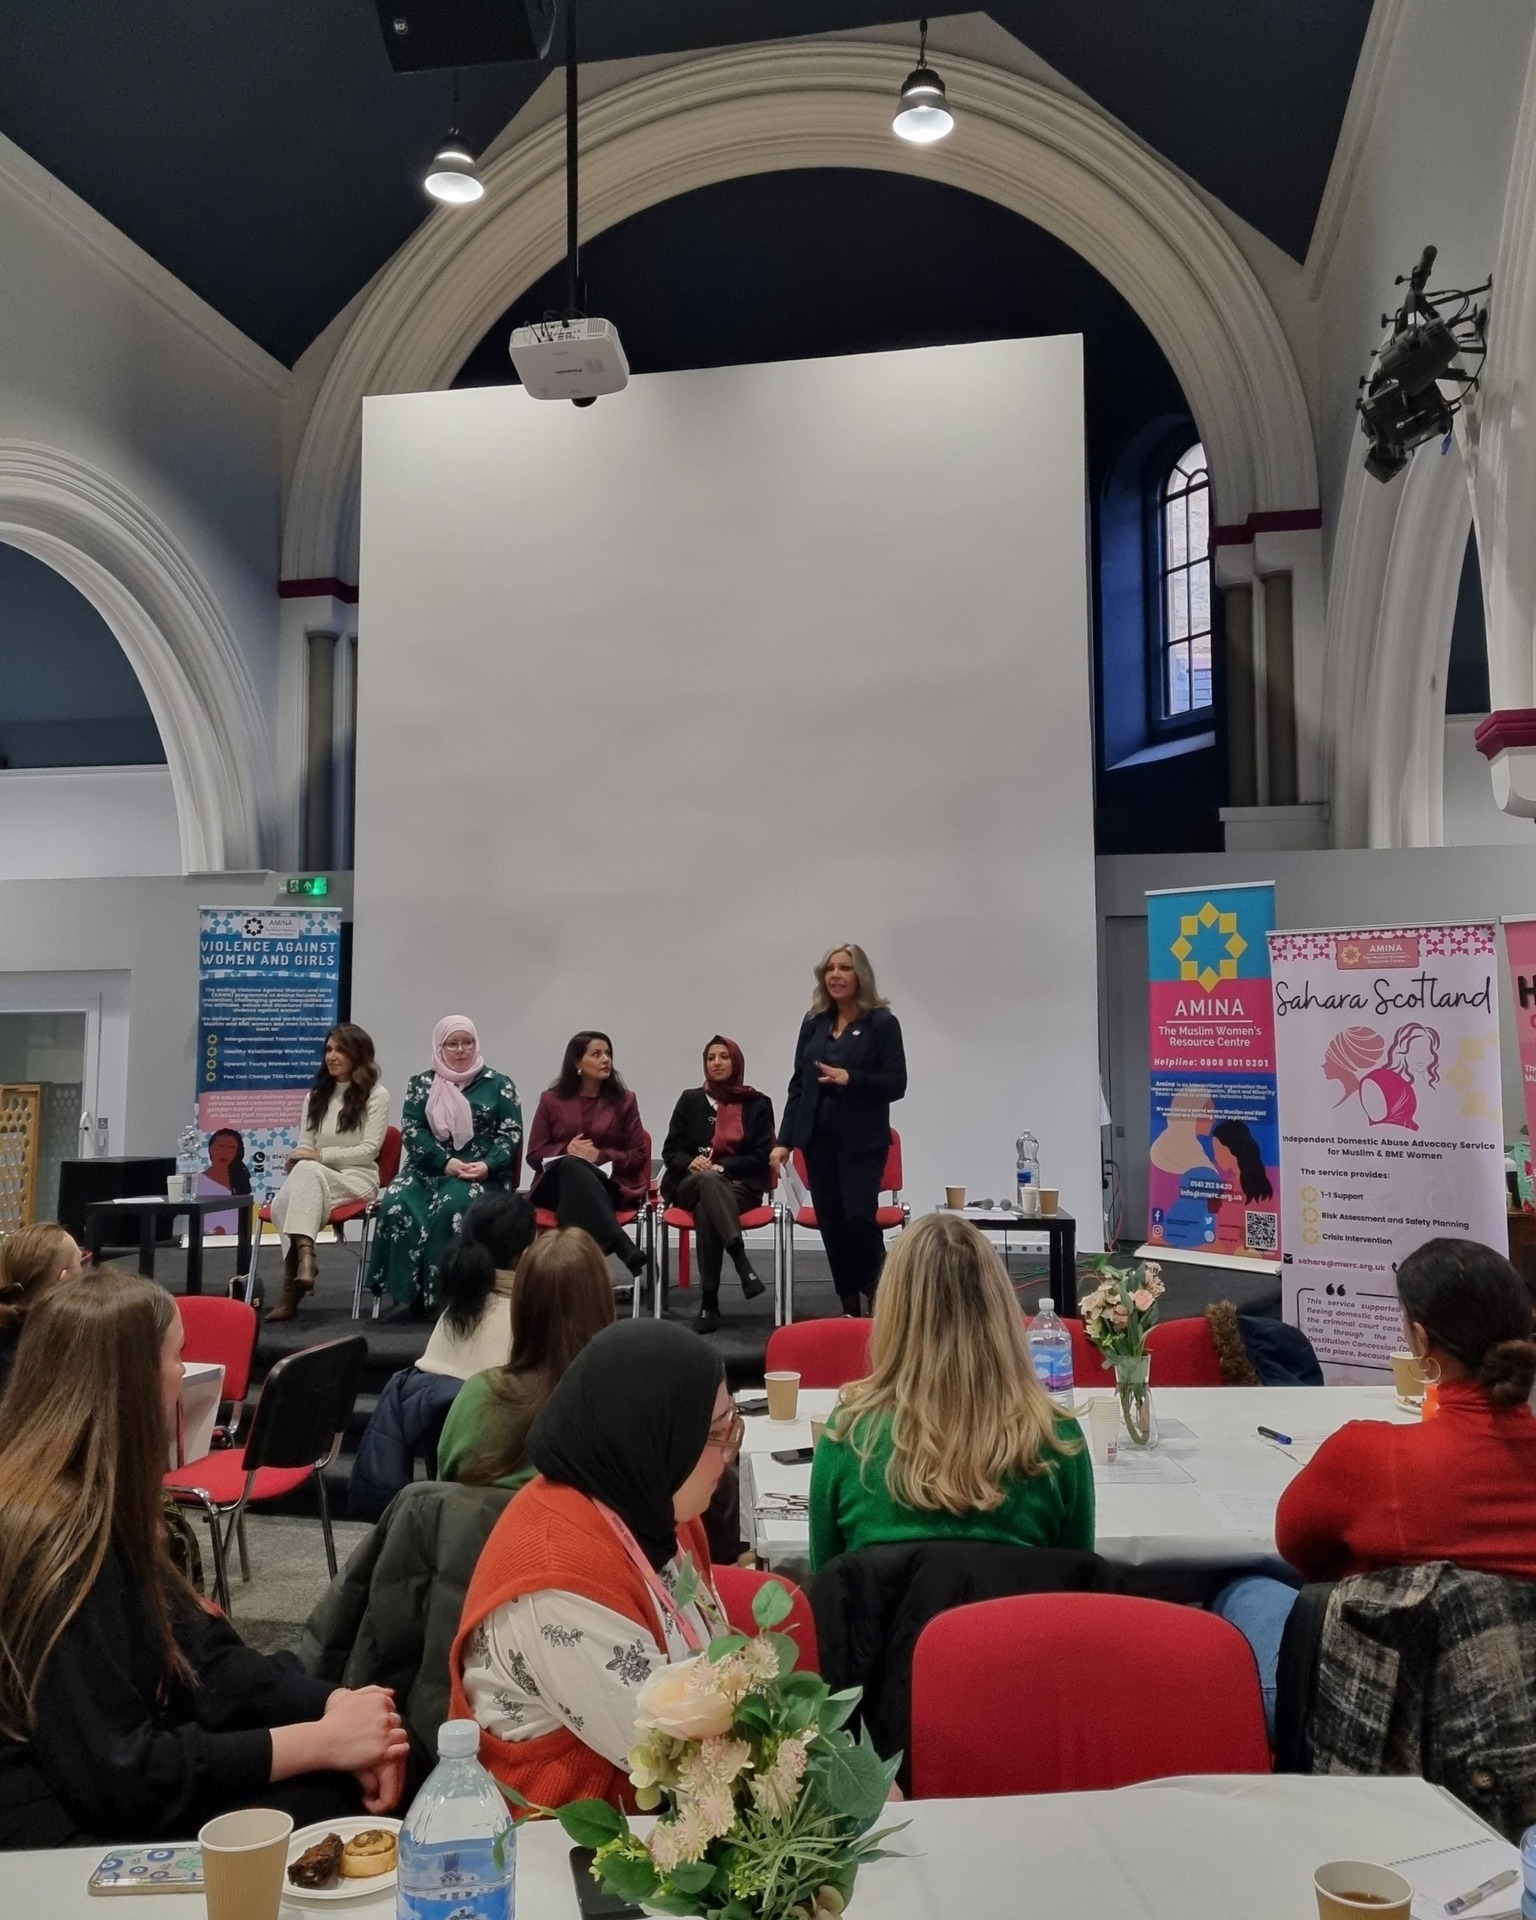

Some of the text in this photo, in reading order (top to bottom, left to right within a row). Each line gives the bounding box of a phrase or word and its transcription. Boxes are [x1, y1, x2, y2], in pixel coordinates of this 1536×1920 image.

[269, 919, 293, 927] AMINA
[201, 941, 336, 953] VIOLENCE AGAINST
[1369, 944, 1403, 953] AMINA
[201, 954, 335, 966] WOMEN AND GIRLS
[1275, 971, 1491, 1016] Sahara Scotland
[1517, 974, 1536, 1009] H
[1175, 998, 1245, 1016] AMINA
[1158, 1026, 1262, 1036] The Muslim Women's
[1169, 1037, 1251, 1047] Resource Centre
[1154, 1058, 1269, 1068] Helpline: 0808 801 0301
[1282, 1135, 1496, 1151] Independent Domestic Abuse Advocacy Service
[1327, 1147, 1340, 1156] for
[1341, 1148, 1375, 1157] Muslim
[1385, 1150, 1404, 1159] BME
[1406, 1151, 1443, 1160] Women
[1318, 1169, 1348, 1177] service
[1350, 1171, 1391, 1180] provides:
[1180, 1189, 1243, 1201] info@mwrc.org.uk
[1333, 1192, 1364, 1201] Support
[1339, 1213, 1386, 1223] Assessment
[1387, 1217, 1403, 1225] and
[1405, 1218, 1431, 1228] Safety
[1432, 1219, 1470, 1231] Planning
[1322, 1233, 1393, 1245] Crisis Intervention
[1298, 1258, 1386, 1272] sahara@mwrc.org.uk
[1328, 1299, 1355, 1308] service
[1306, 1307, 1399, 1323] fleeing domestic abuse
[1307, 1316, 1320, 1324] the
[1323, 1318, 1355, 1328] criminal
[1358, 1321, 1380, 1330] court
[1307, 1326, 1387, 1340] visa through the
[1351, 1340, 1396, 1352] Concession
[1315, 1346, 1391, 1361] safe place, because
